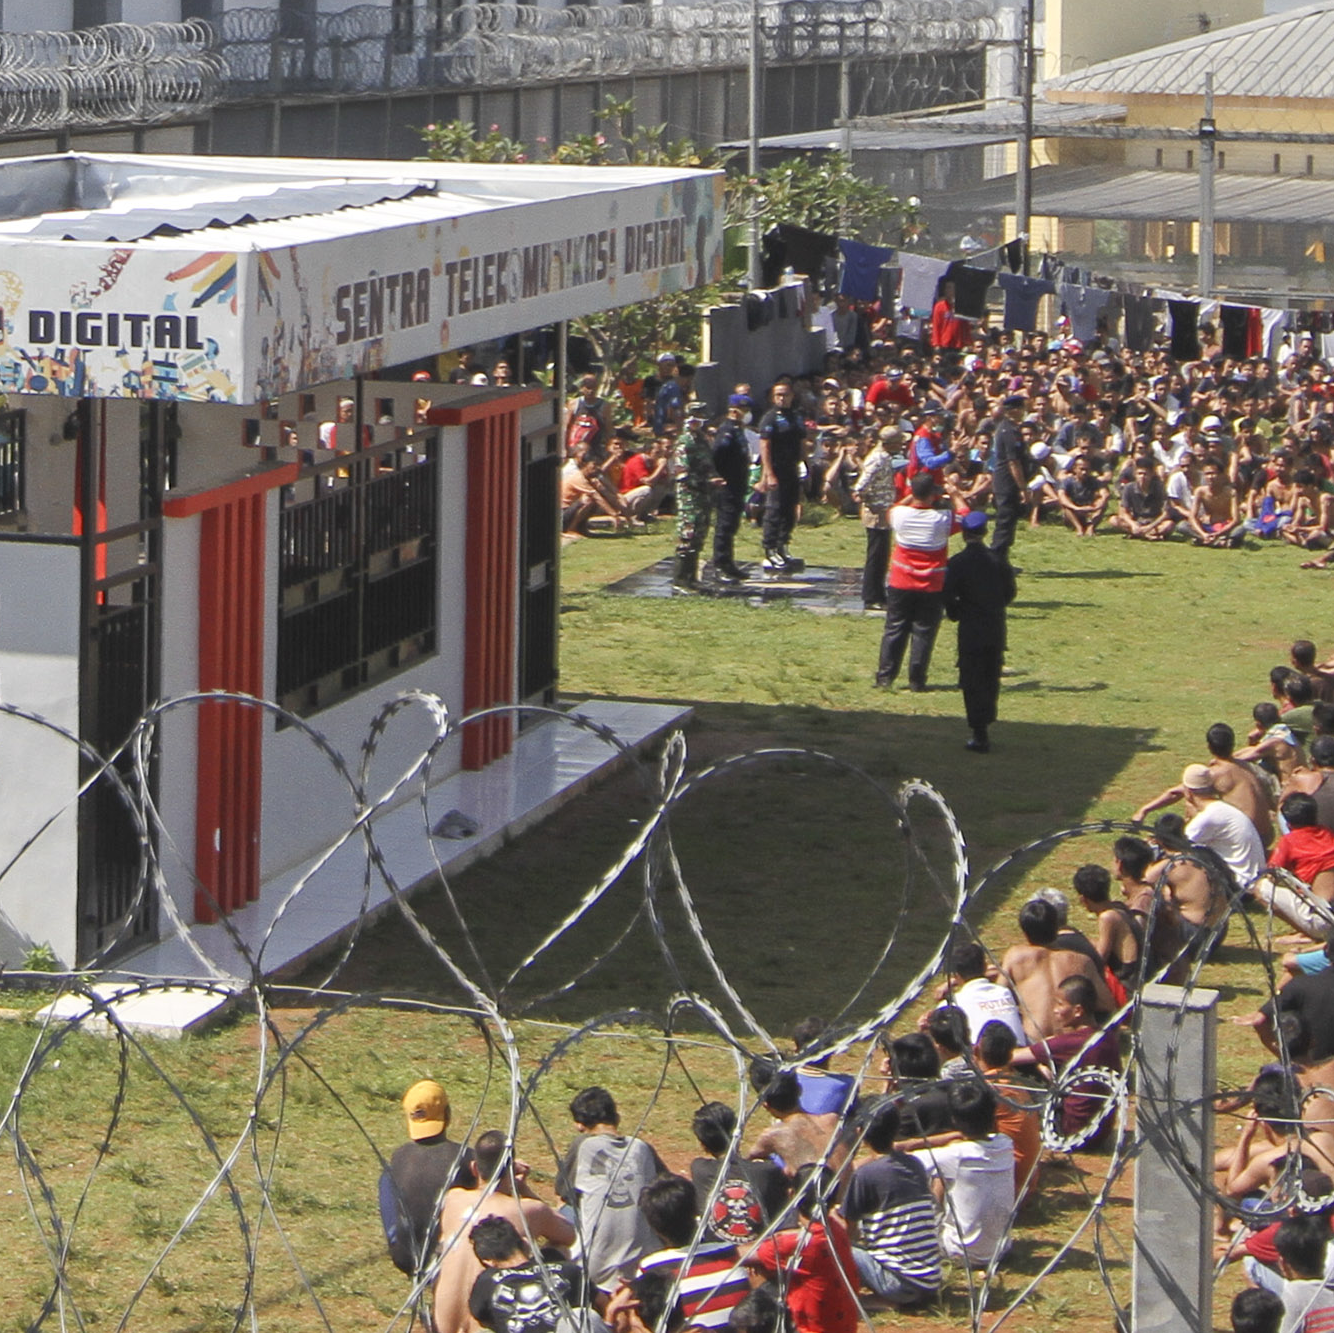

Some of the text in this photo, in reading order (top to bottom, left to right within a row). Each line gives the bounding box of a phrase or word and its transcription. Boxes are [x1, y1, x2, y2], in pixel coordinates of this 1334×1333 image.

[336, 267, 430, 345] SENTRA
[625, 217, 686, 274] DIGITAL
[28, 310, 204, 350] DIGITAL
